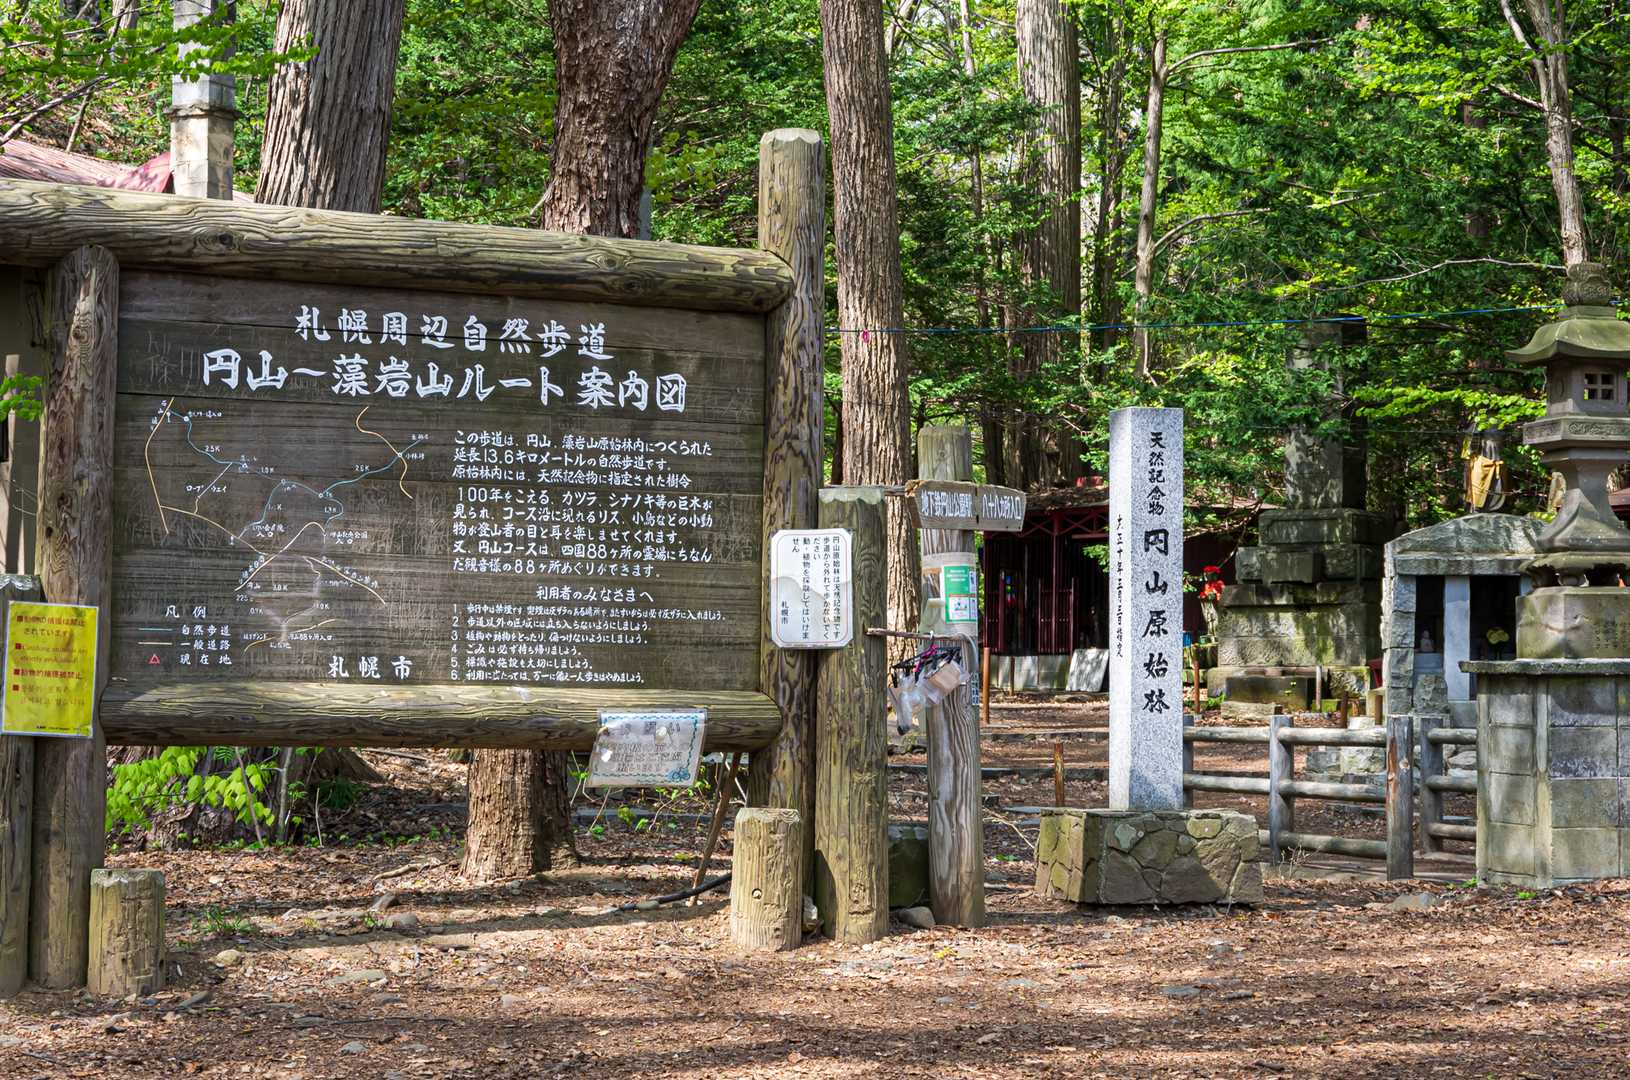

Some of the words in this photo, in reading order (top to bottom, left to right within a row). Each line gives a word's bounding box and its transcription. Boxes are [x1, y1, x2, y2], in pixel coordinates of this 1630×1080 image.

[295, 304, 615, 360] 札幌周辺自然歩道
[1147, 431, 1166, 516] 天然記念物
[536, 584, 654, 602] 利用者のみなさまへ
[181, 624, 231, 637] 自然歩道
[1142, 528, 1171, 714] 円山原始林
[328, 655, 413, 679] 札幌市
